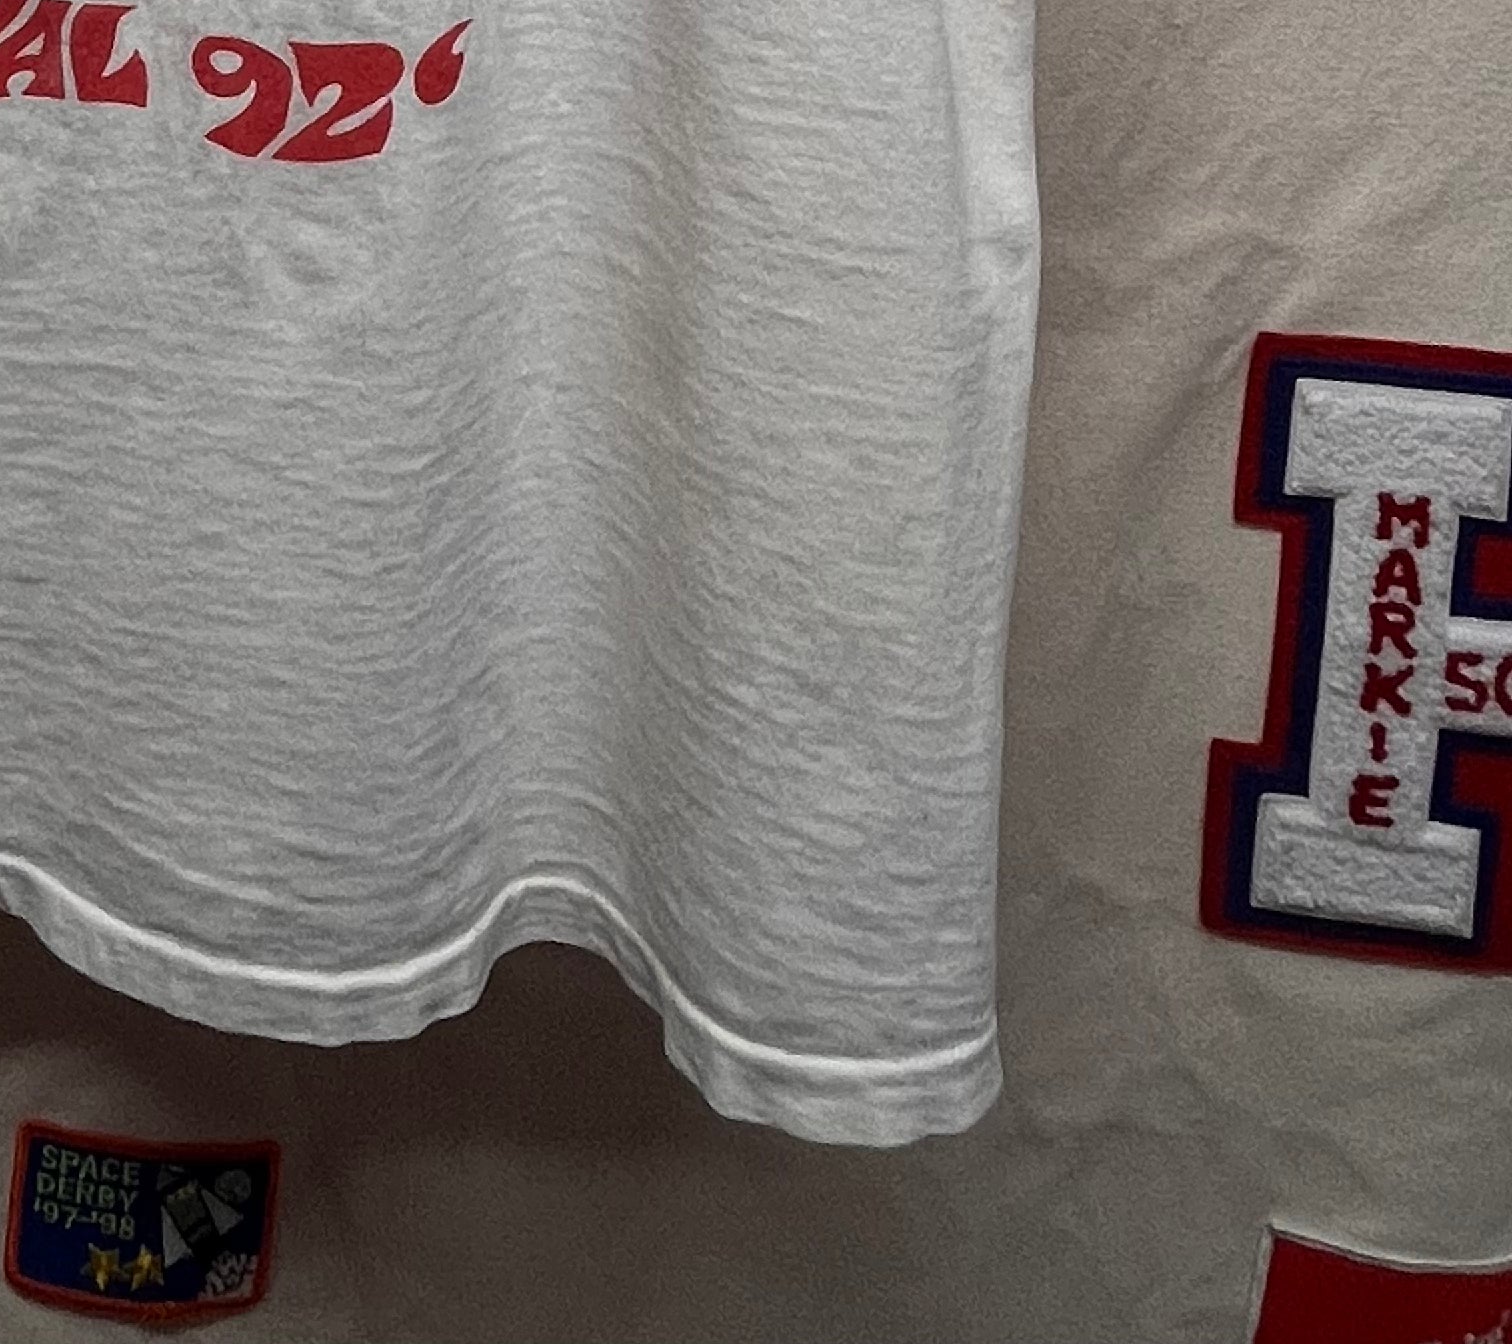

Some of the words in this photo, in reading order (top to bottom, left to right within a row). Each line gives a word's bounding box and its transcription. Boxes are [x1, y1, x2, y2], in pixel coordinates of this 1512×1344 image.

[1347, 490, 1432, 829] MARKIE
[40, 1143, 142, 1187] SPACE
[35, 1171, 140, 1214] DERBY
